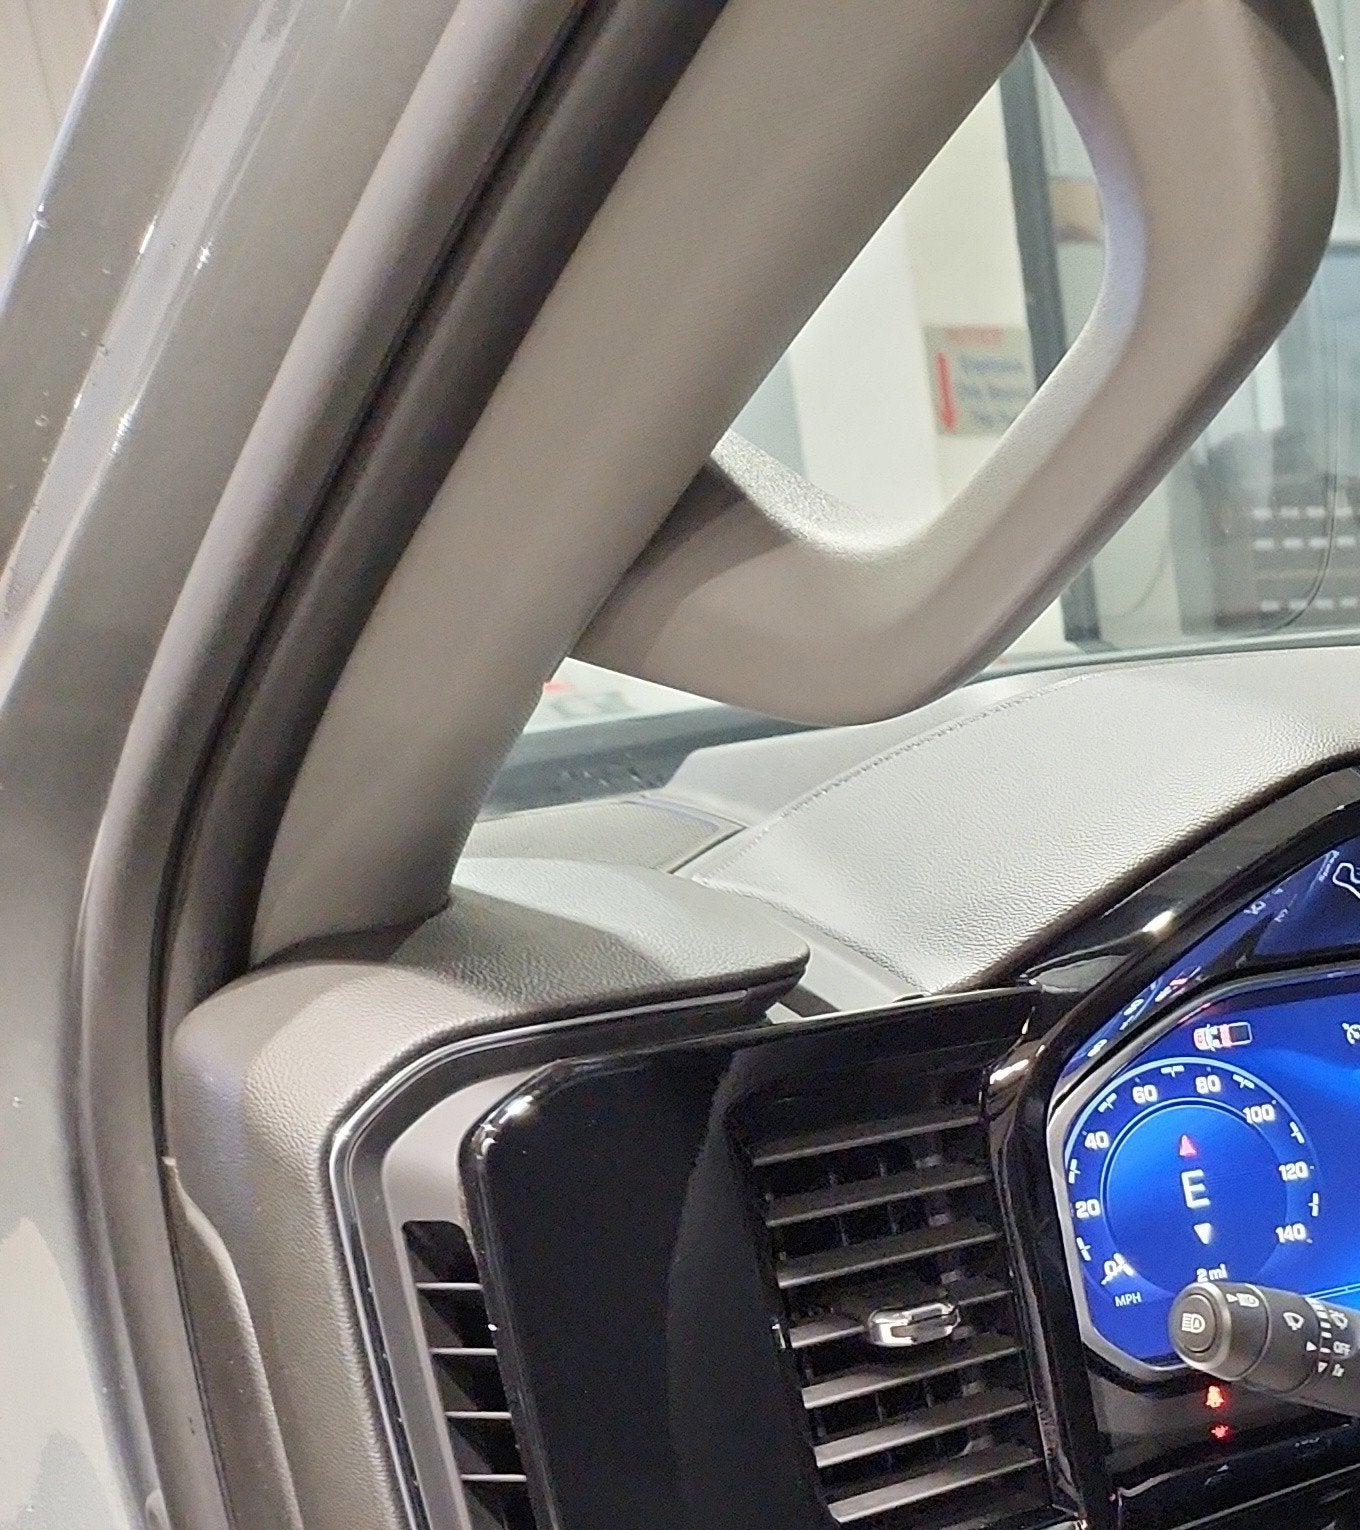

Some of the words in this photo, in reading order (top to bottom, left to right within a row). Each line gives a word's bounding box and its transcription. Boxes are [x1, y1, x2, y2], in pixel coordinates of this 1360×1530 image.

[1132, 1084, 1158, 1104] 60
[1195, 1075, 1222, 1094] 80
[1243, 1103, 1276, 1124] 100
[1084, 1130, 1110, 1149] 40
[1278, 1161, 1309, 1182] 120
[1180, 1168, 1211, 1209] E
[1075, 1199, 1101, 1218] 20
[1275, 1223, 1307, 1244] 140
[1196, 1267, 1210, 1283] 2
[1209, 1263, 1229, 1281] mi
[1114, 1291, 1142, 1308] MPH
